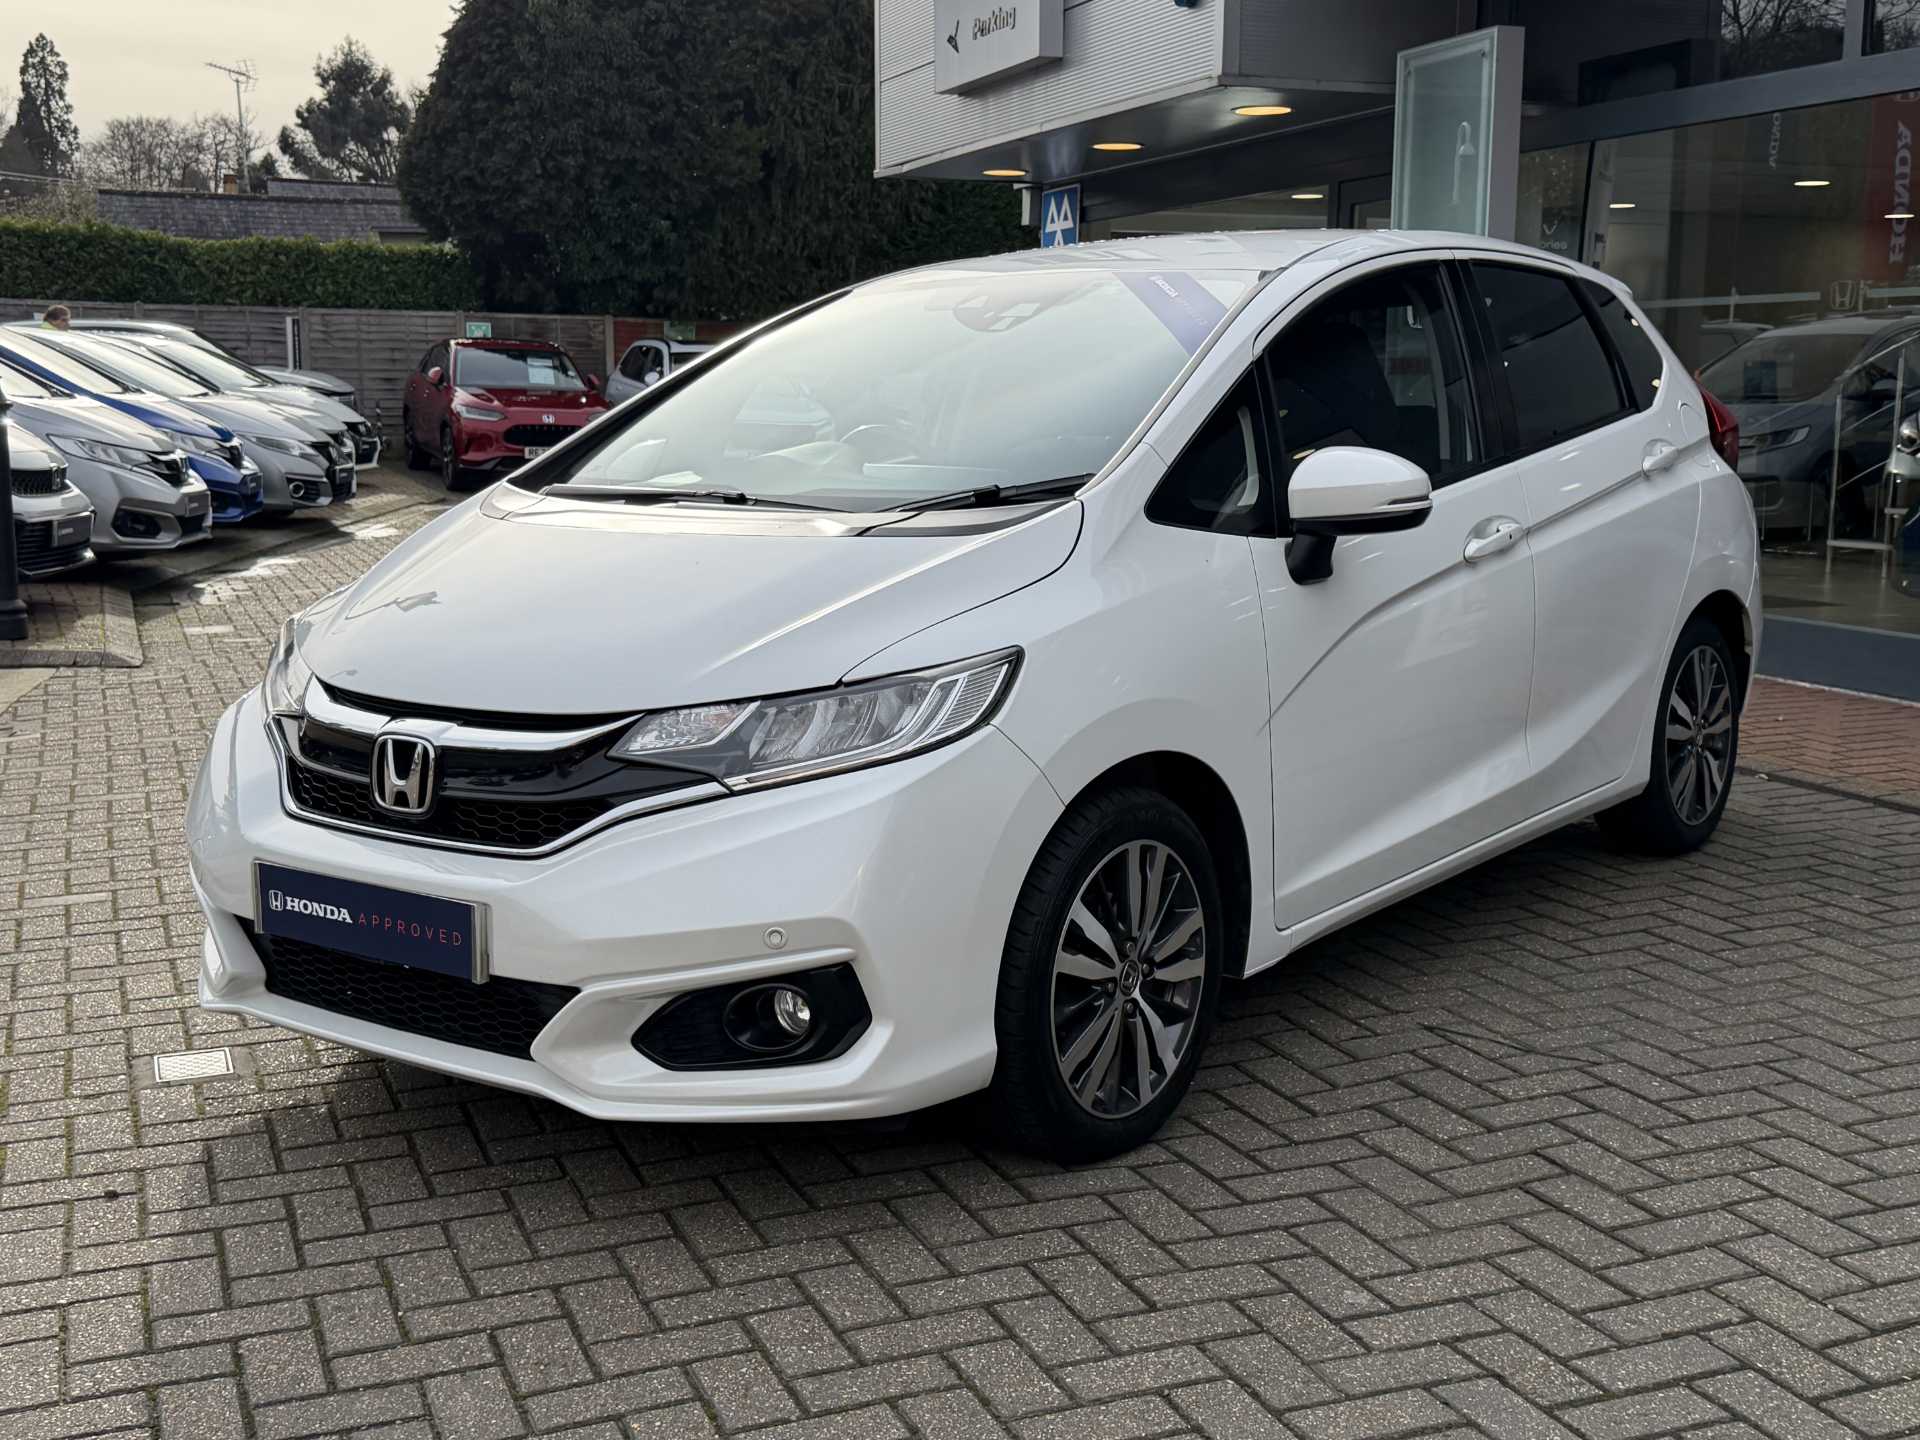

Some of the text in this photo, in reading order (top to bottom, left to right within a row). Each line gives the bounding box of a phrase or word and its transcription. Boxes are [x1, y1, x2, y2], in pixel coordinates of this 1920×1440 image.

[972, 7, 1016, 40] Parking
[286, 896, 353, 924] HONDA
[358, 912, 462, 946] APPROVED
